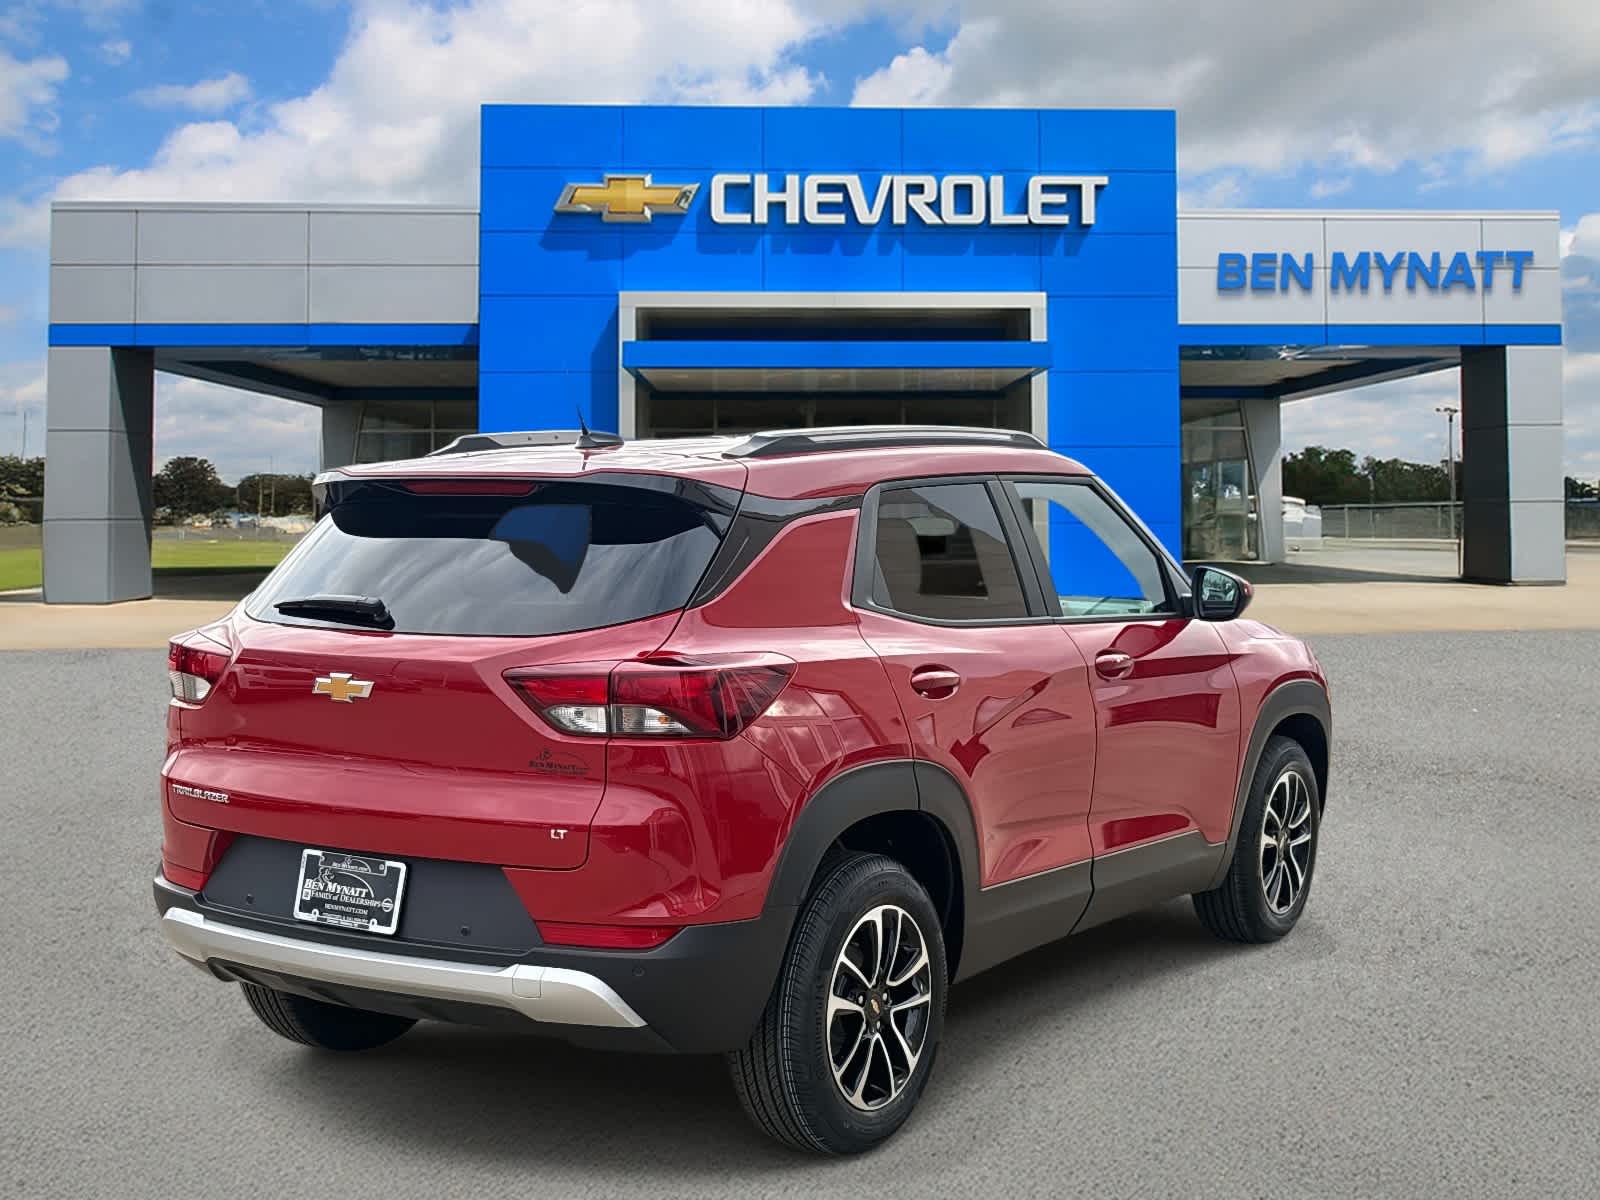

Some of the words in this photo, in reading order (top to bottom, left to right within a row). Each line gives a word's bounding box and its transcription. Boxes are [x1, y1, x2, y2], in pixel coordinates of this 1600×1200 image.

[711, 173, 1109, 225] CHEVROLET
[1217, 253, 1313, 290] BEN
[1330, 250, 1533, 290] MYNATT
[172, 784, 230, 803] TRAILBLAZER
[550, 829, 568, 840] LT
[304, 879, 325, 890] BEN
[326, 881, 368, 898] MYNATT
[311, 890, 333, 900] FAMILY
[340, 895, 381, 908] DEALERSHIPS
